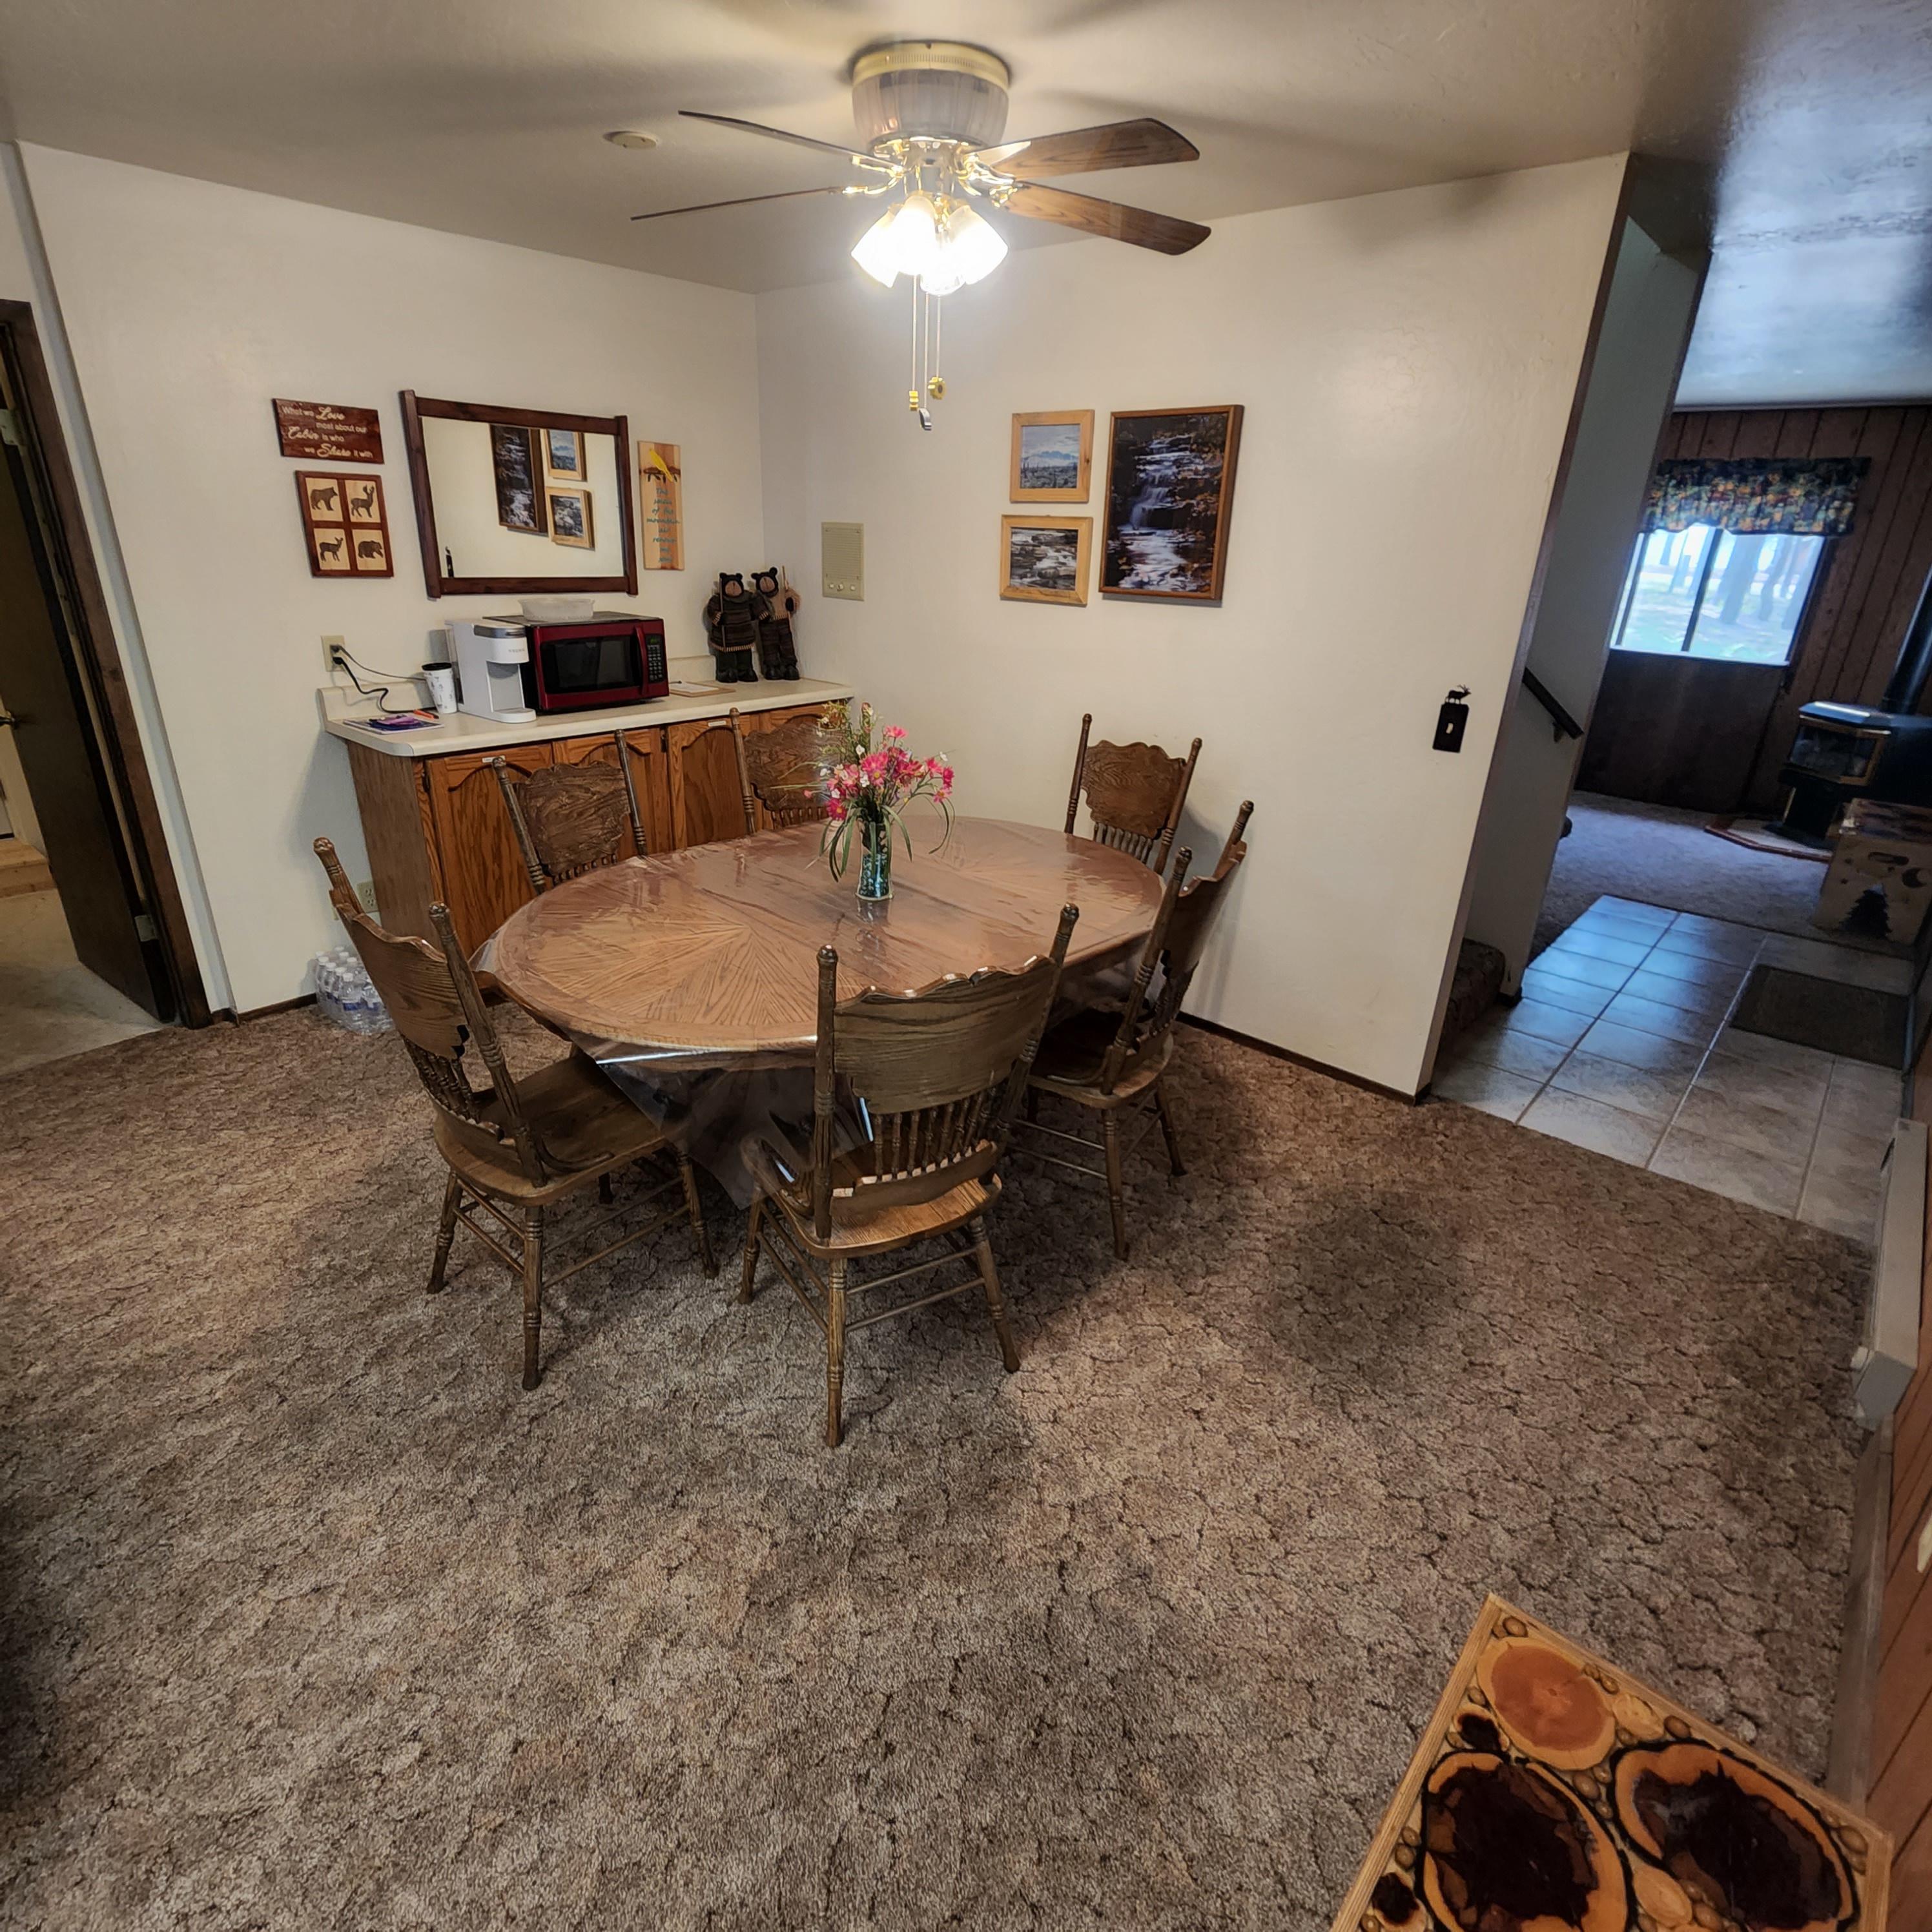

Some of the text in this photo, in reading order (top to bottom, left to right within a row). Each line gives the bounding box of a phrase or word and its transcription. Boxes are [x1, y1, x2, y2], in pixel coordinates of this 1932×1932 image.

[282, 406, 303, 415] What
[315, 406, 345, 420] Love
[287, 426, 320, 440] Cabin
[316, 443, 351, 458] Share
[359, 450, 373, 458] with
